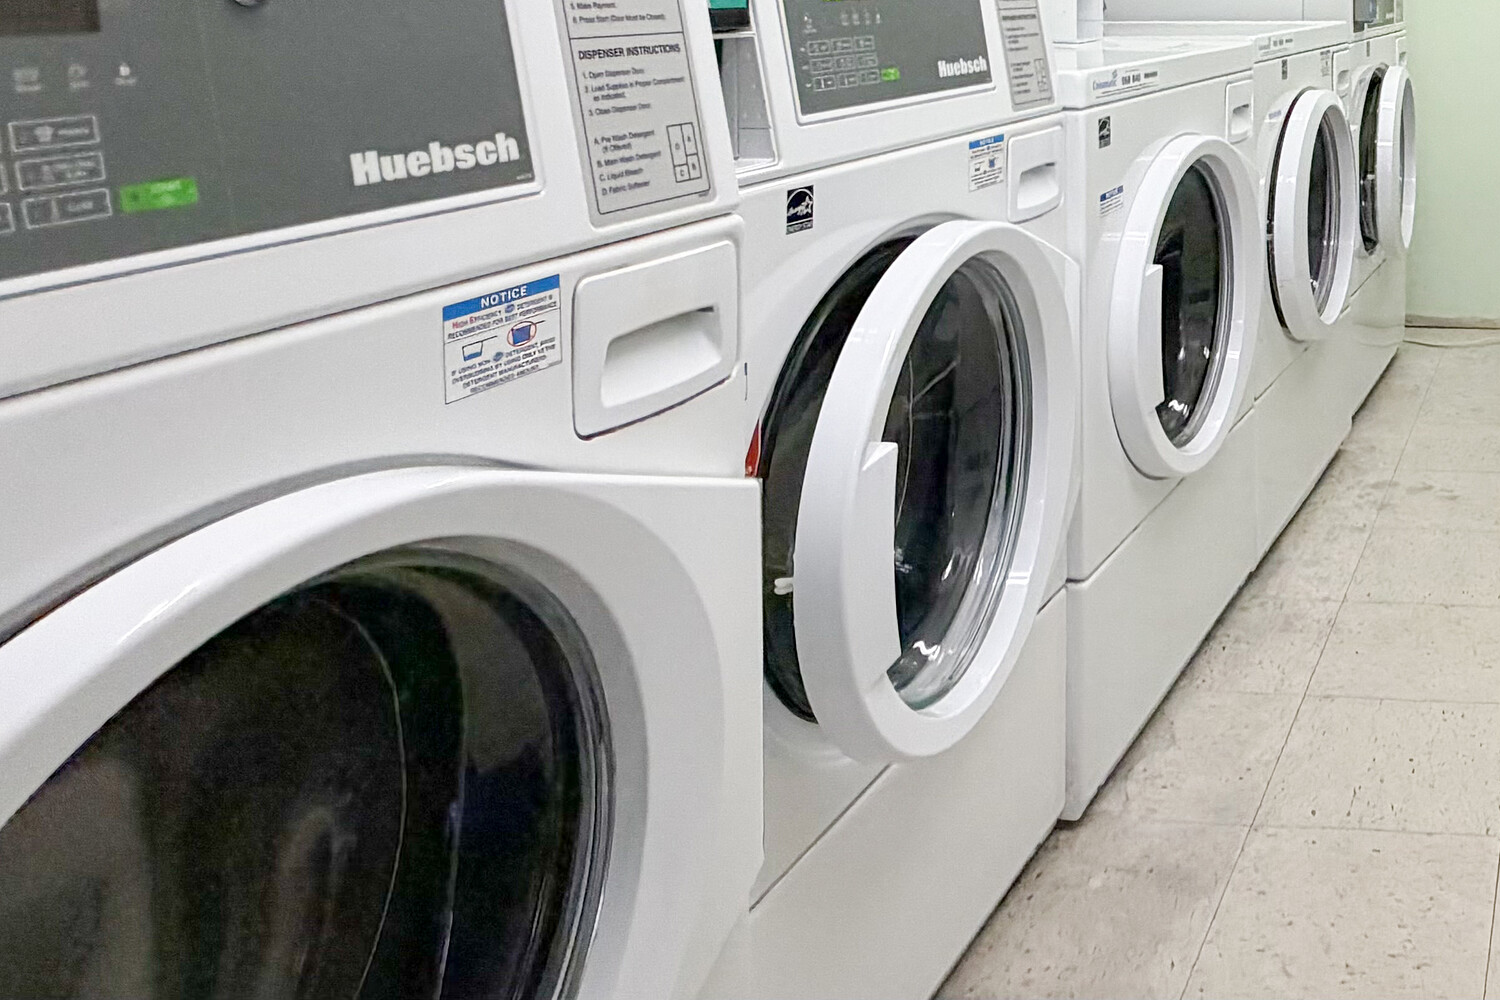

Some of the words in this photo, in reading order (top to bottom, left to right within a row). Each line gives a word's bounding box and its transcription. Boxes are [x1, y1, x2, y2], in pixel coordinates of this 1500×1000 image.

[578, 47, 626, 60] DISPENSER
[626, 43, 681, 57] INSTRUCTIONS
[937, 55, 988, 78] Huebsch
[349, 131, 520, 186] Huebsch
[480, 285, 529, 309] NOTICE
